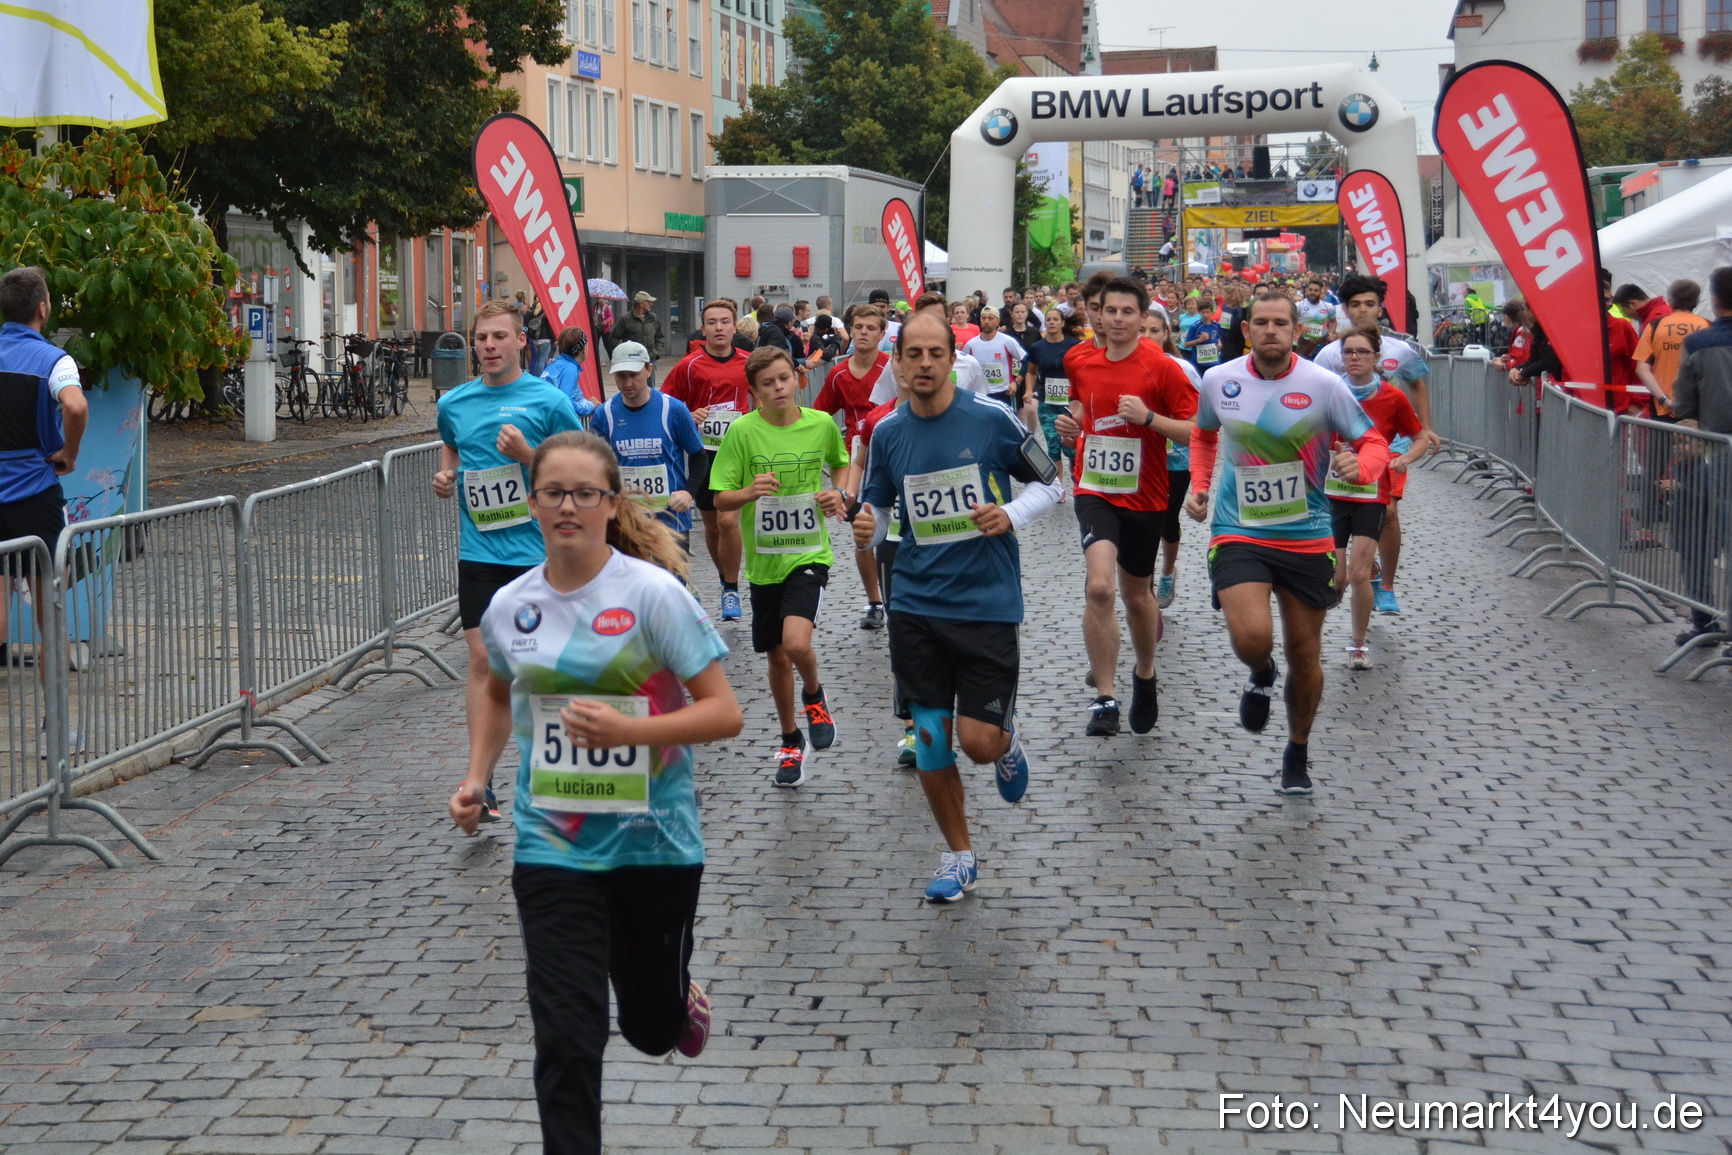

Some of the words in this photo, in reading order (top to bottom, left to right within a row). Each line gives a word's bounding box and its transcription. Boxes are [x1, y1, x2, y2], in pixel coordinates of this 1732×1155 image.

[1031, 89, 1131, 120] BMW
[1142, 81, 1323, 119] Laufsport
[1244, 210, 1278, 223] ZIEL
[252, 311, 261, 327] P
[1664, 323, 1702, 336] TSV
[1199, 347, 1216, 356] 5020
[1662, 342, 1683, 351] Die
[983, 368, 1002, 378] 243
[1047, 384, 1070, 395] 5033
[1221, 400, 1240, 408] PARTL
[1284, 396, 1308, 406] Hervis
[703, 421, 731, 436] 507
[616, 437, 662, 450] HUBER
[1088, 448, 1134, 472] 5136
[623, 476, 664, 495] 5188
[1244, 475, 1298, 503] 5317
[468, 479, 521, 508] 5112
[912, 484, 978, 518] 5216
[478, 510, 515, 522] Matthias
[1251, 506, 1291, 519] Alexander
[762, 508, 815, 532] 5013
[932, 520, 967, 533] Marius
[773, 537, 806, 546] Hannes
[597, 614, 631, 630] Hervis
[511, 638, 538, 646] PARTL
[555, 777, 615, 796] Luciana
